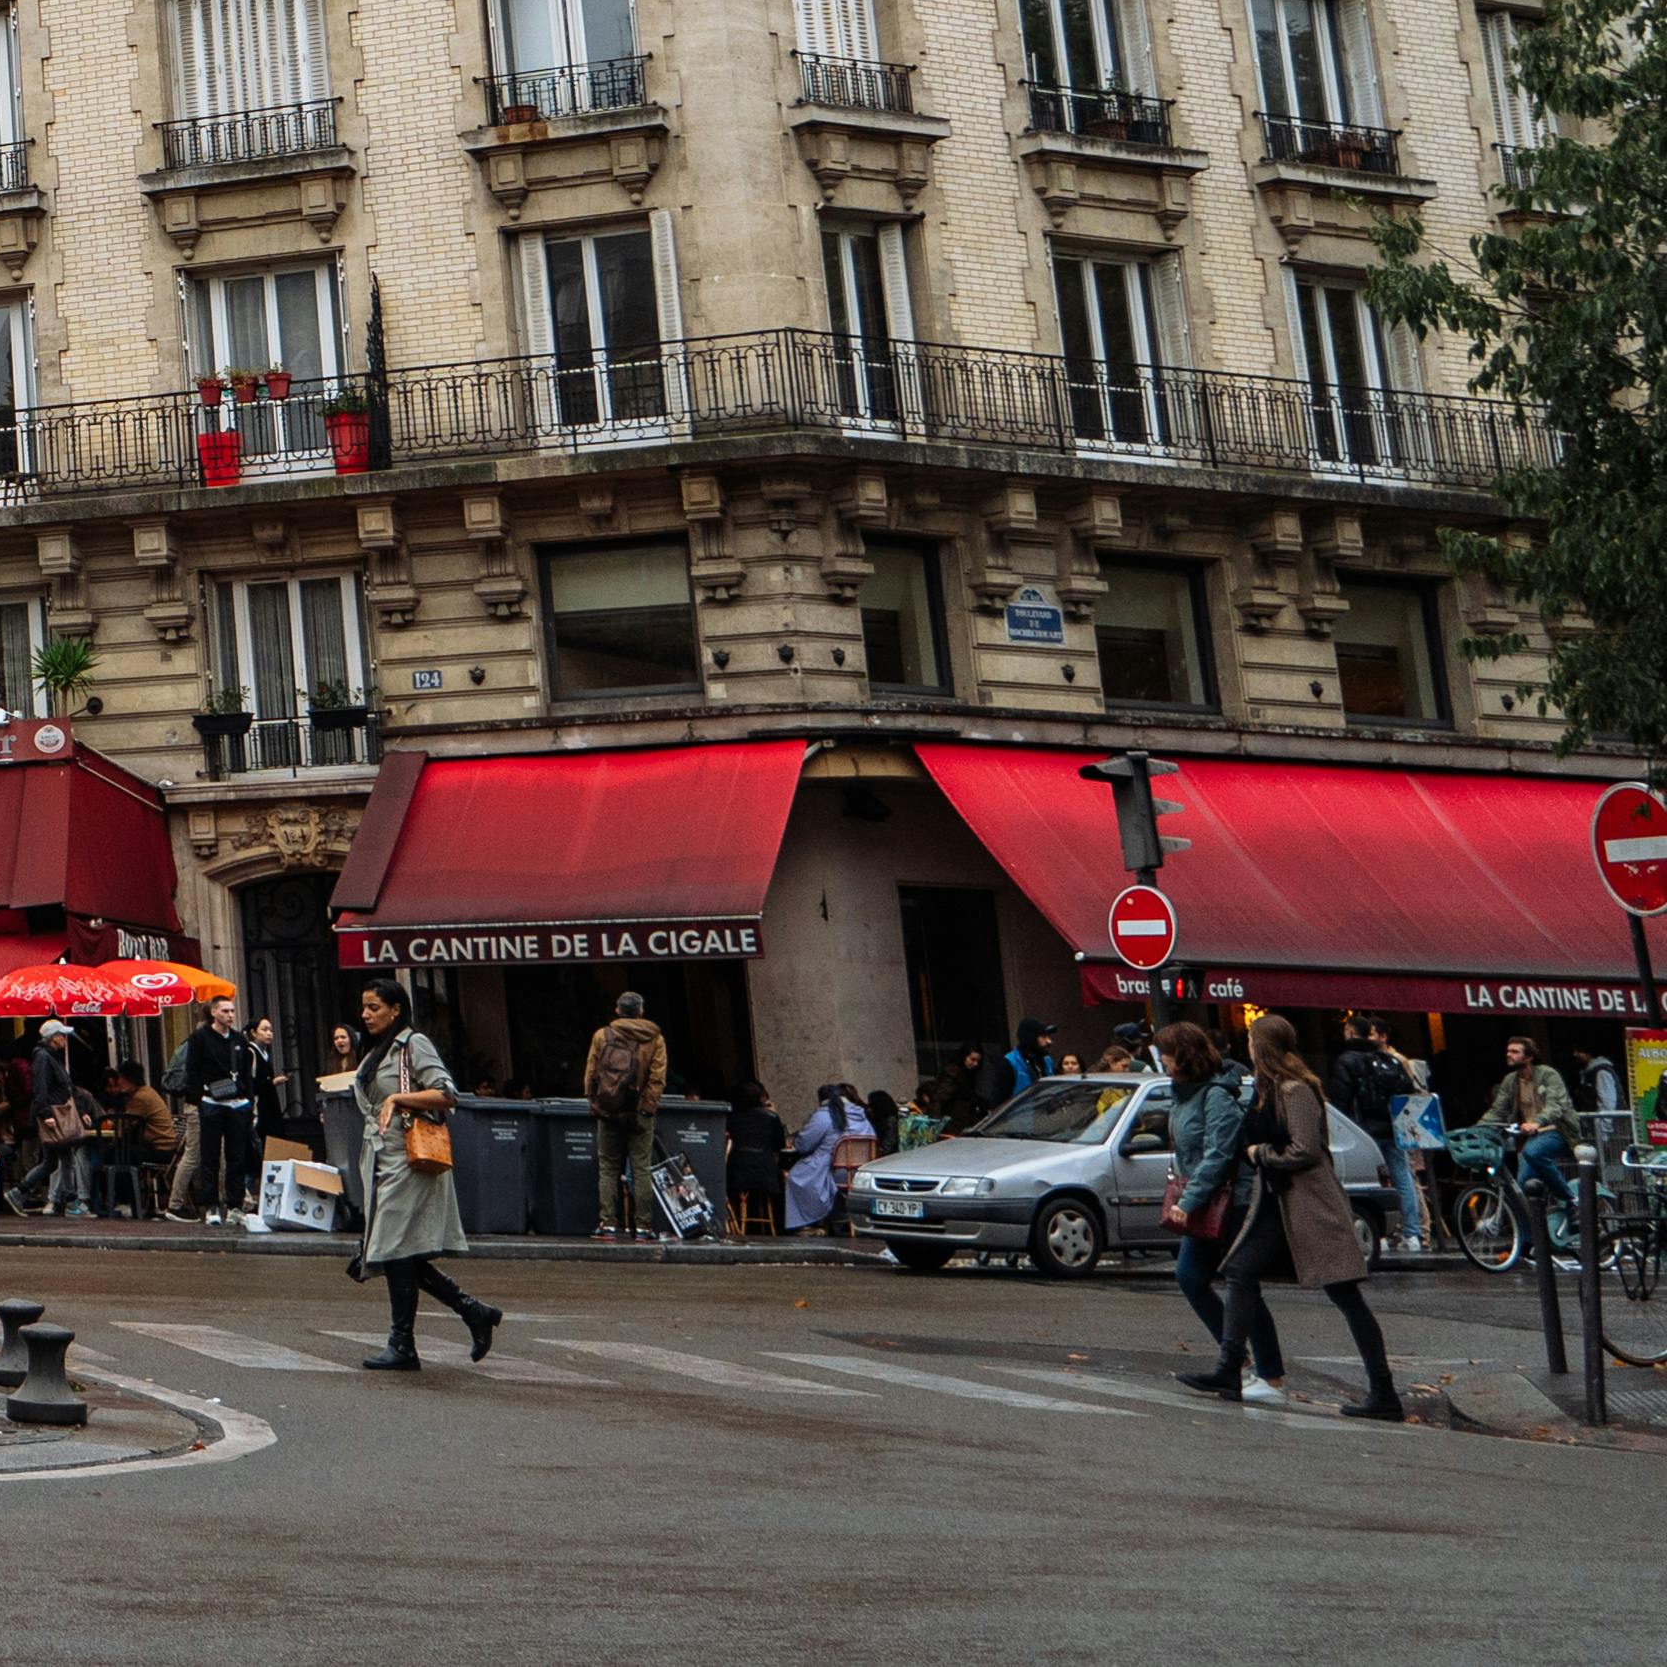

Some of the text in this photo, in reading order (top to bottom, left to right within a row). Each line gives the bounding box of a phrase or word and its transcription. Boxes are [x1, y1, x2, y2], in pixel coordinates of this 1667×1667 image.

[414, 671, 440, 688] 124
[362, 927, 758, 964] LA CANTINE DE LA CIGALE
[1208, 977, 1245, 999] café
[1464, 984, 1495, 1008] LA
[1498, 985, 1593, 1012] CANTINE
[1596, 988, 1626, 1012] DE
[1629, 990, 1648, 1013] L
